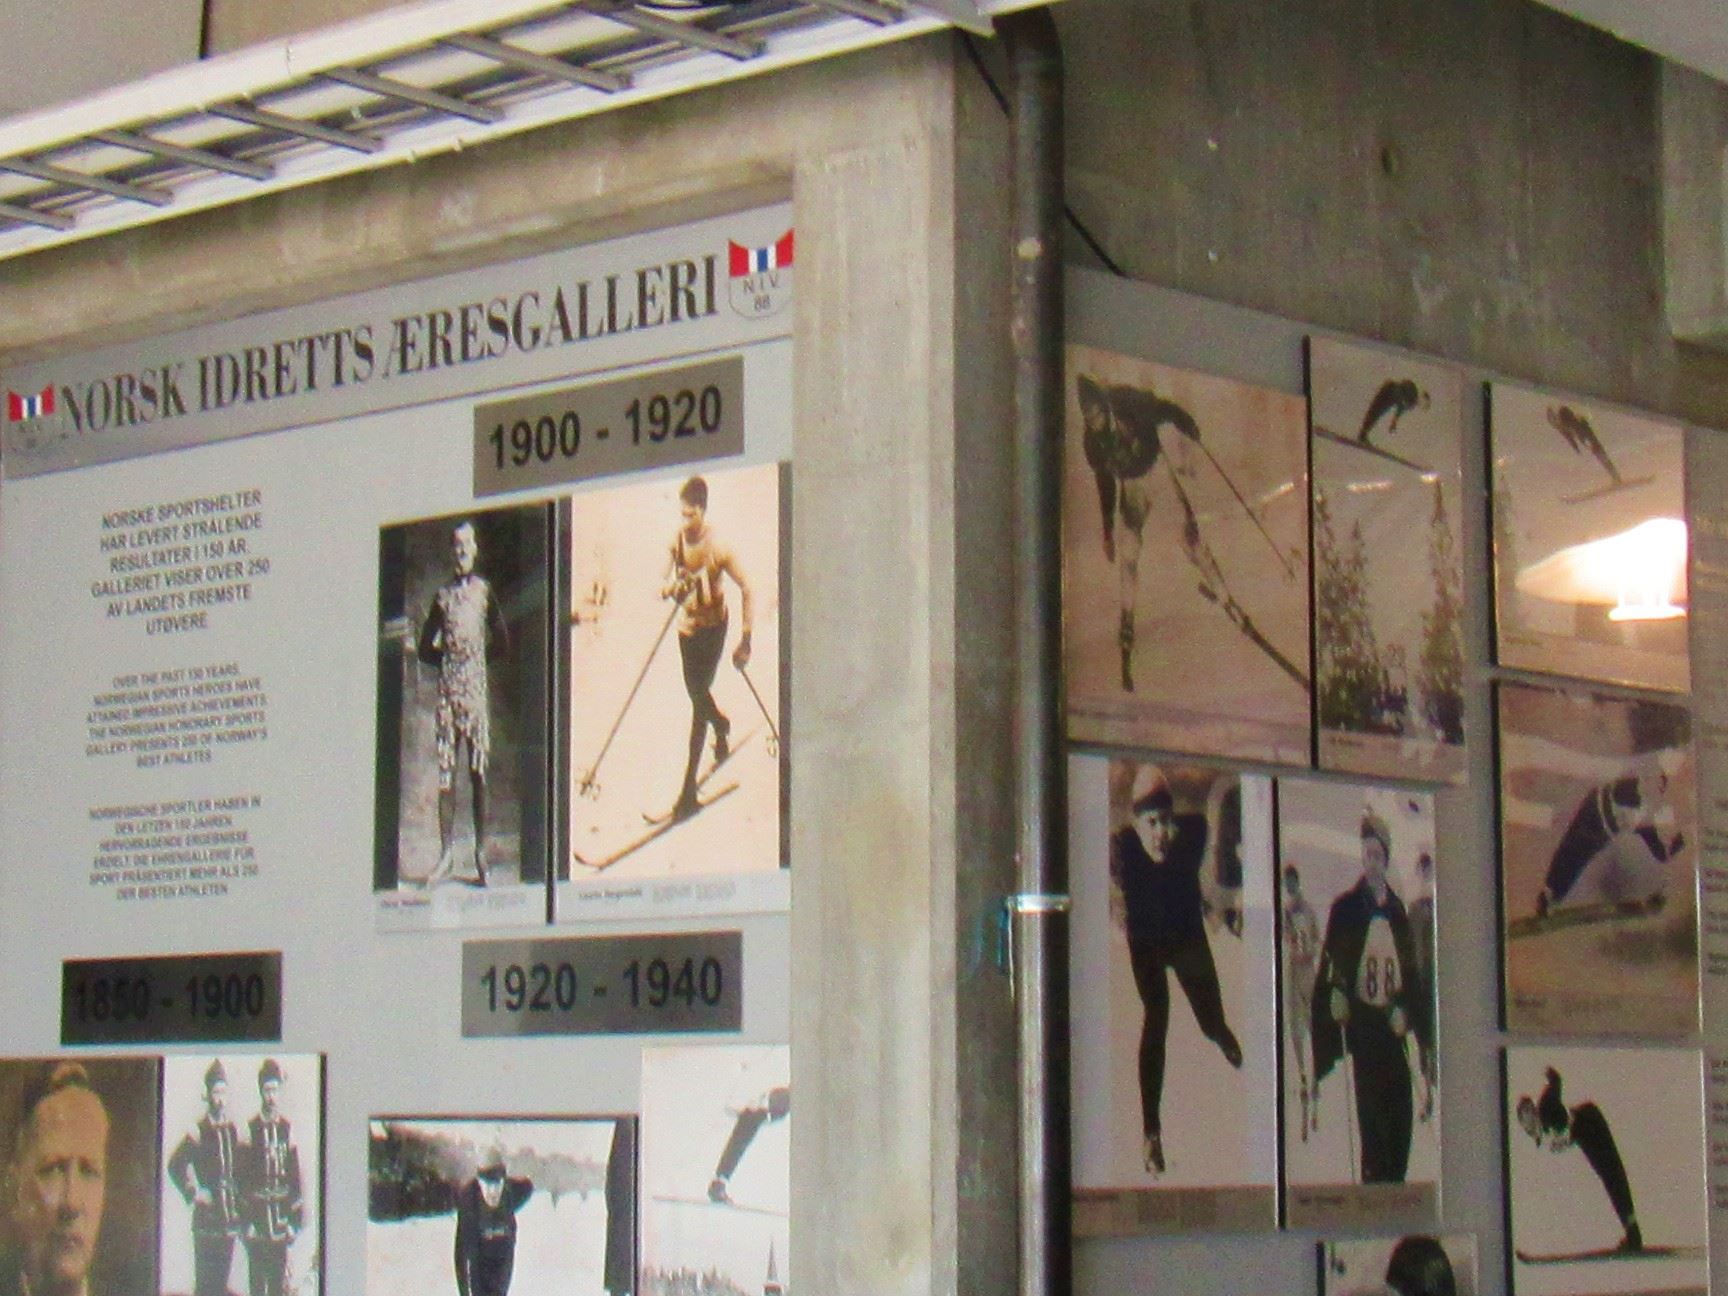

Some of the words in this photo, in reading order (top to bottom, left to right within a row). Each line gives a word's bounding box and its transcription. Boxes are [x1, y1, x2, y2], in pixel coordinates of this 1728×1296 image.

[61, 361, 187, 434] NORSK
[197, 325, 376, 412] IDRETTS
[382, 254, 720, 380] ÆRESGALLERI
[488, 410, 582, 470] 1900
[625, 384, 723, 445] 1920
[101, 506, 155, 530] NORSKE
[158, 488, 262, 522] SPORTSHELTER
[100, 533, 127, 552] HAR
[129, 525, 180, 548] LEVERT
[110, 545, 192, 573] RESULTATER
[90, 572, 161, 598] GALLERIET
[164, 565, 203, 588] VISER
[205, 560, 245, 581] OVER
[106, 601, 123, 618] AV
[126, 591, 187, 616] LANDETS
[188, 582, 253, 607] FREMSTE
[185, 972, 265, 1020] 1900
[480, 960, 578, 1014] 1920
[623, 956, 723, 1008] 1940
